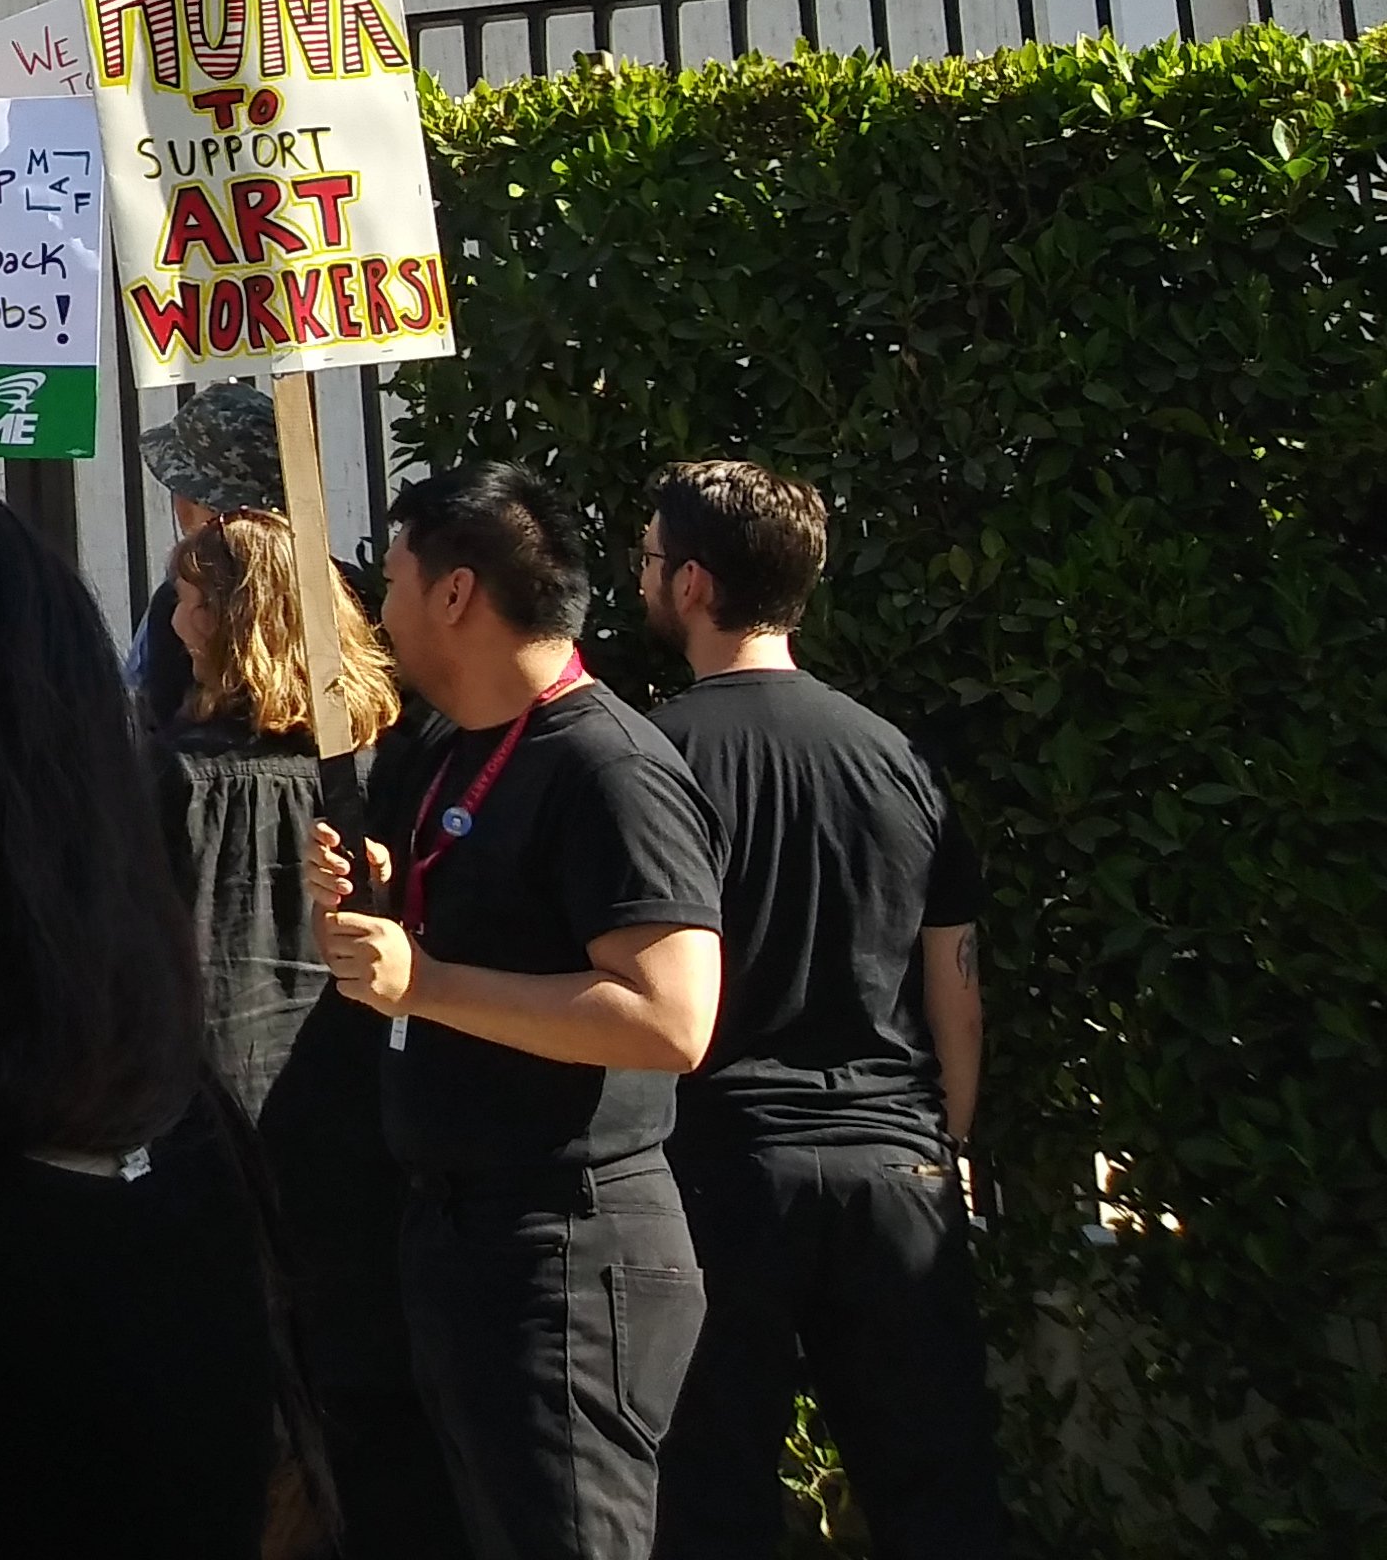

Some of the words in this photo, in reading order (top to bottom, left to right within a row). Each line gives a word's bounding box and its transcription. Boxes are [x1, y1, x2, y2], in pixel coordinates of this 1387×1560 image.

[11, 26, 79, 76] WE
[193, 86, 280, 133] TO
[136, 127, 332, 180] SUPPORT
[161, 172, 356, 266] ART
[127, 256, 447, 357] WORKERS!
